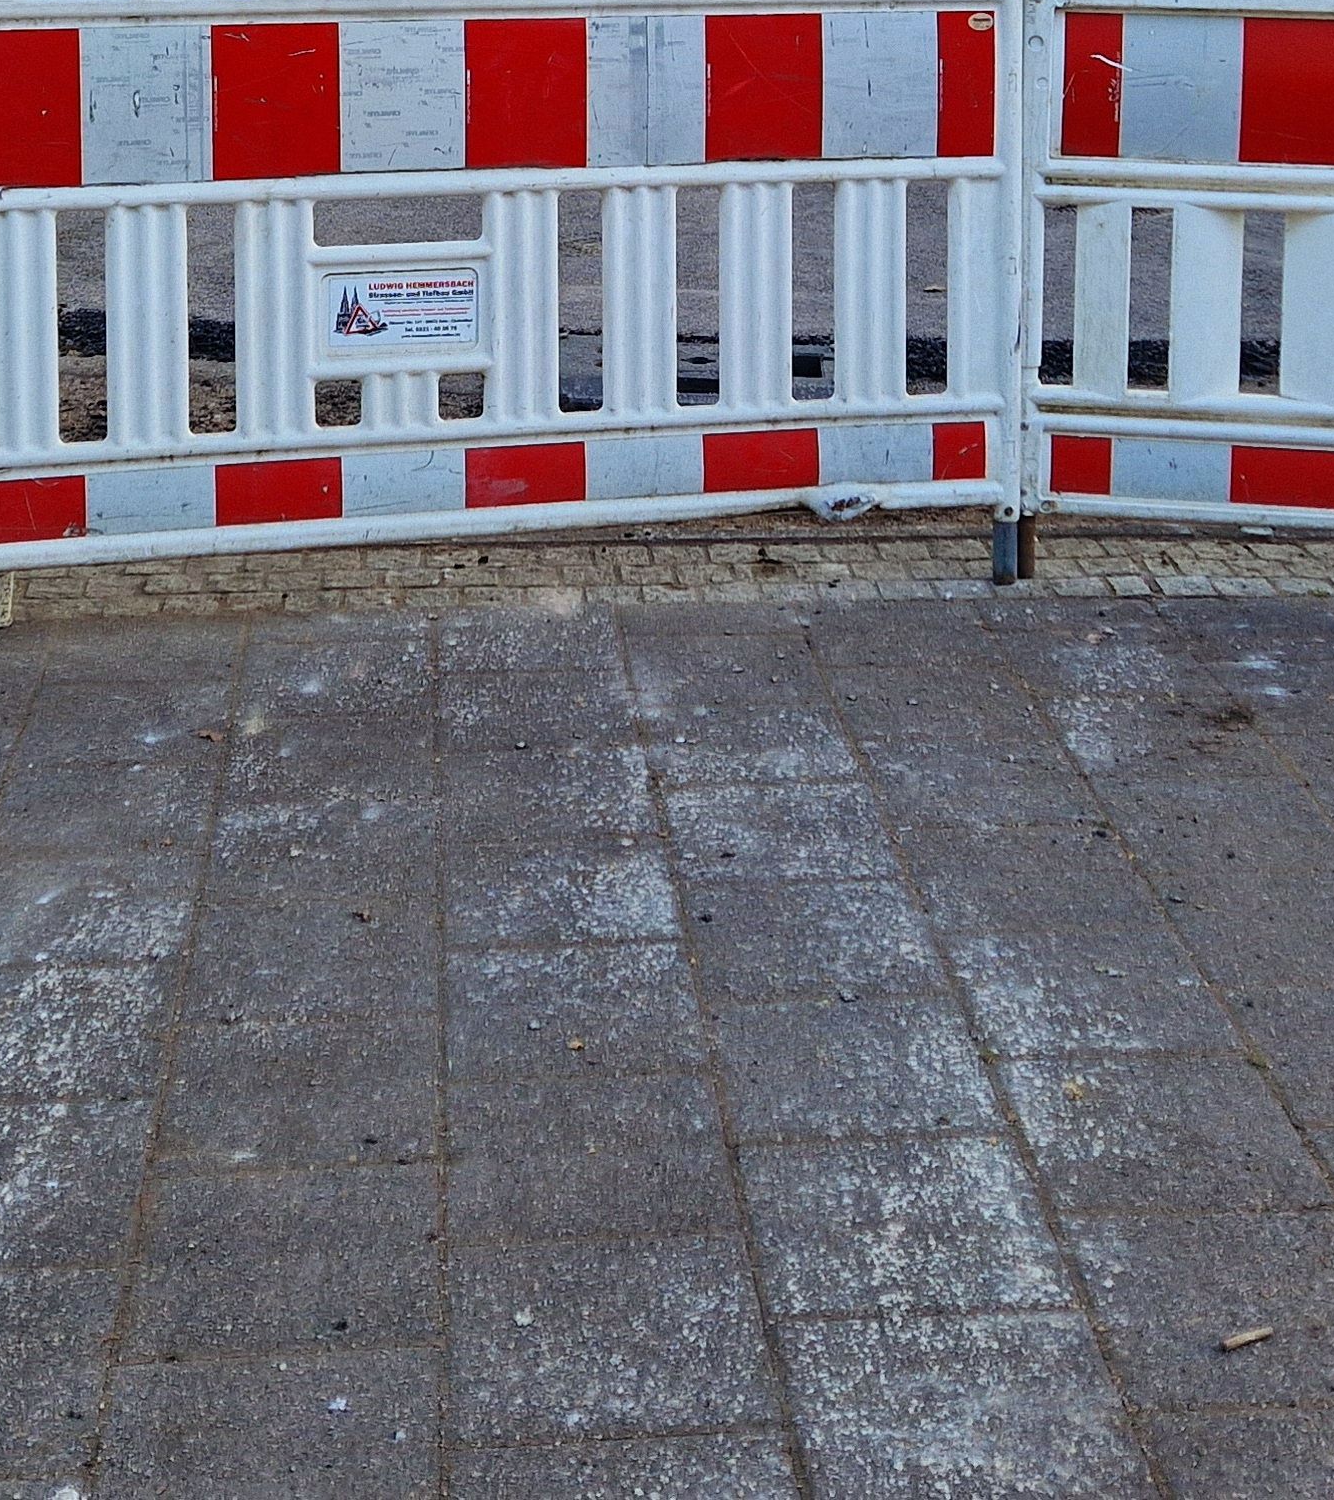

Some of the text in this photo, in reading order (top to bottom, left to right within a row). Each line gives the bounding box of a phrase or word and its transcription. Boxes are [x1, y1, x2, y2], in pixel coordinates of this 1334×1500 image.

[368, 280, 474, 291] LUDWIG HEMMERSBACH
[405, 290, 420, 298] und
[422, 289, 450, 297] Tiefbau
[451, 288, 474, 296] GmbH
